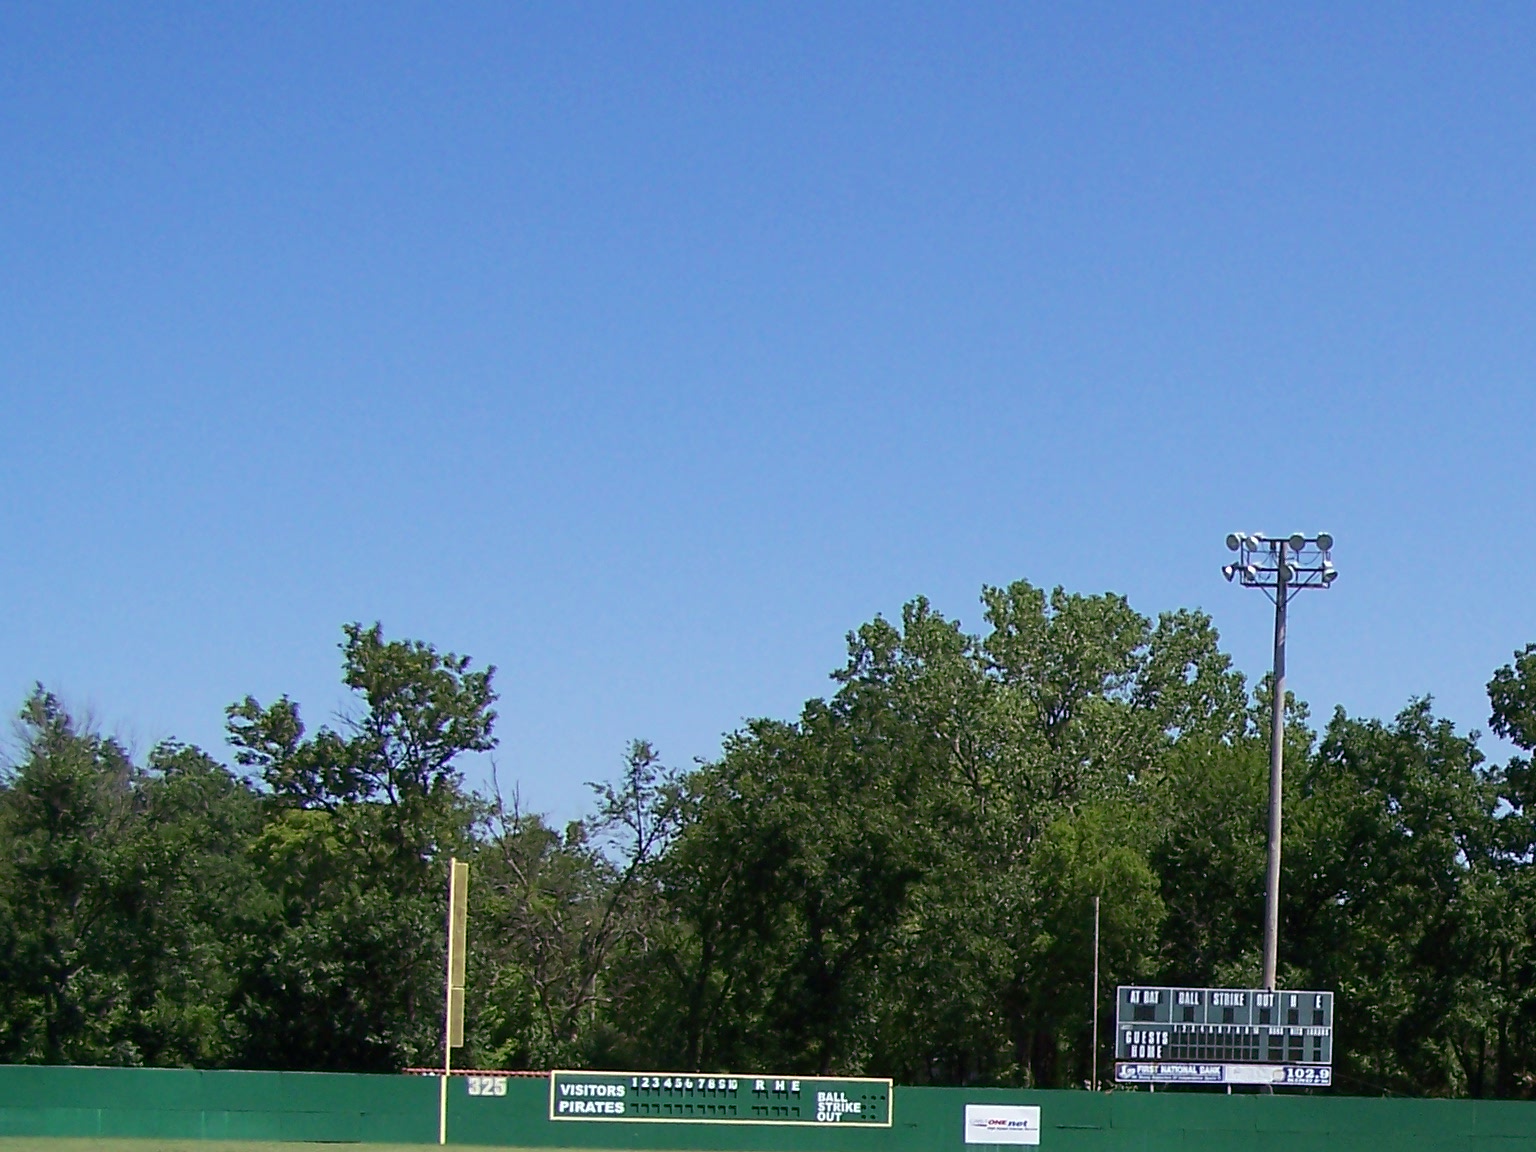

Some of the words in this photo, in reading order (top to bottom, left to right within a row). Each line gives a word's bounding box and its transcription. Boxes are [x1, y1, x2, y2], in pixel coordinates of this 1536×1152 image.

[1130, 990, 1140, 1004] AT
[1143, 990, 1159, 1004] BAT
[1178, 991, 1199, 1005] BALL
[1213, 992, 1244, 1006] STRIKE
[1257, 993, 1274, 1007] OUT
[1316, 995, 1321, 1009] E
[1125, 1031, 1168, 1045] GUESTS
[1131, 1045, 1162, 1058] HOME
[1160, 1065, 1197, 1074] NATIONAL
[1199, 1065, 1221, 1075] BANK
[1287, 1068, 1329, 1079] 102.9
[468, 1076, 507, 1096] 325
[631, 1077, 638, 1087] 1
[641, 1078, 650, 1088] 2
[651, 1078, 660, 1088] 3
[663, 1078, 672, 1088] 4
[674, 1078, 683, 1088] 5
[685, 1078, 693, 1088] 6
[698, 1079, 706, 1089] 7
[708, 1079, 716, 1089] 8
[728, 1080, 738, 1090] 10
[755, 1080, 765, 1091] R
[775, 1080, 785, 1091] H
[791, 1081, 800, 1092] E
[560, 1084, 626, 1097] VISITORS
[817, 1092, 848, 1103] BALL
[559, 1101, 625, 1114] PIRATES
[817, 1102, 862, 1113] STRIKE
[817, 1112, 842, 1122] OUT
